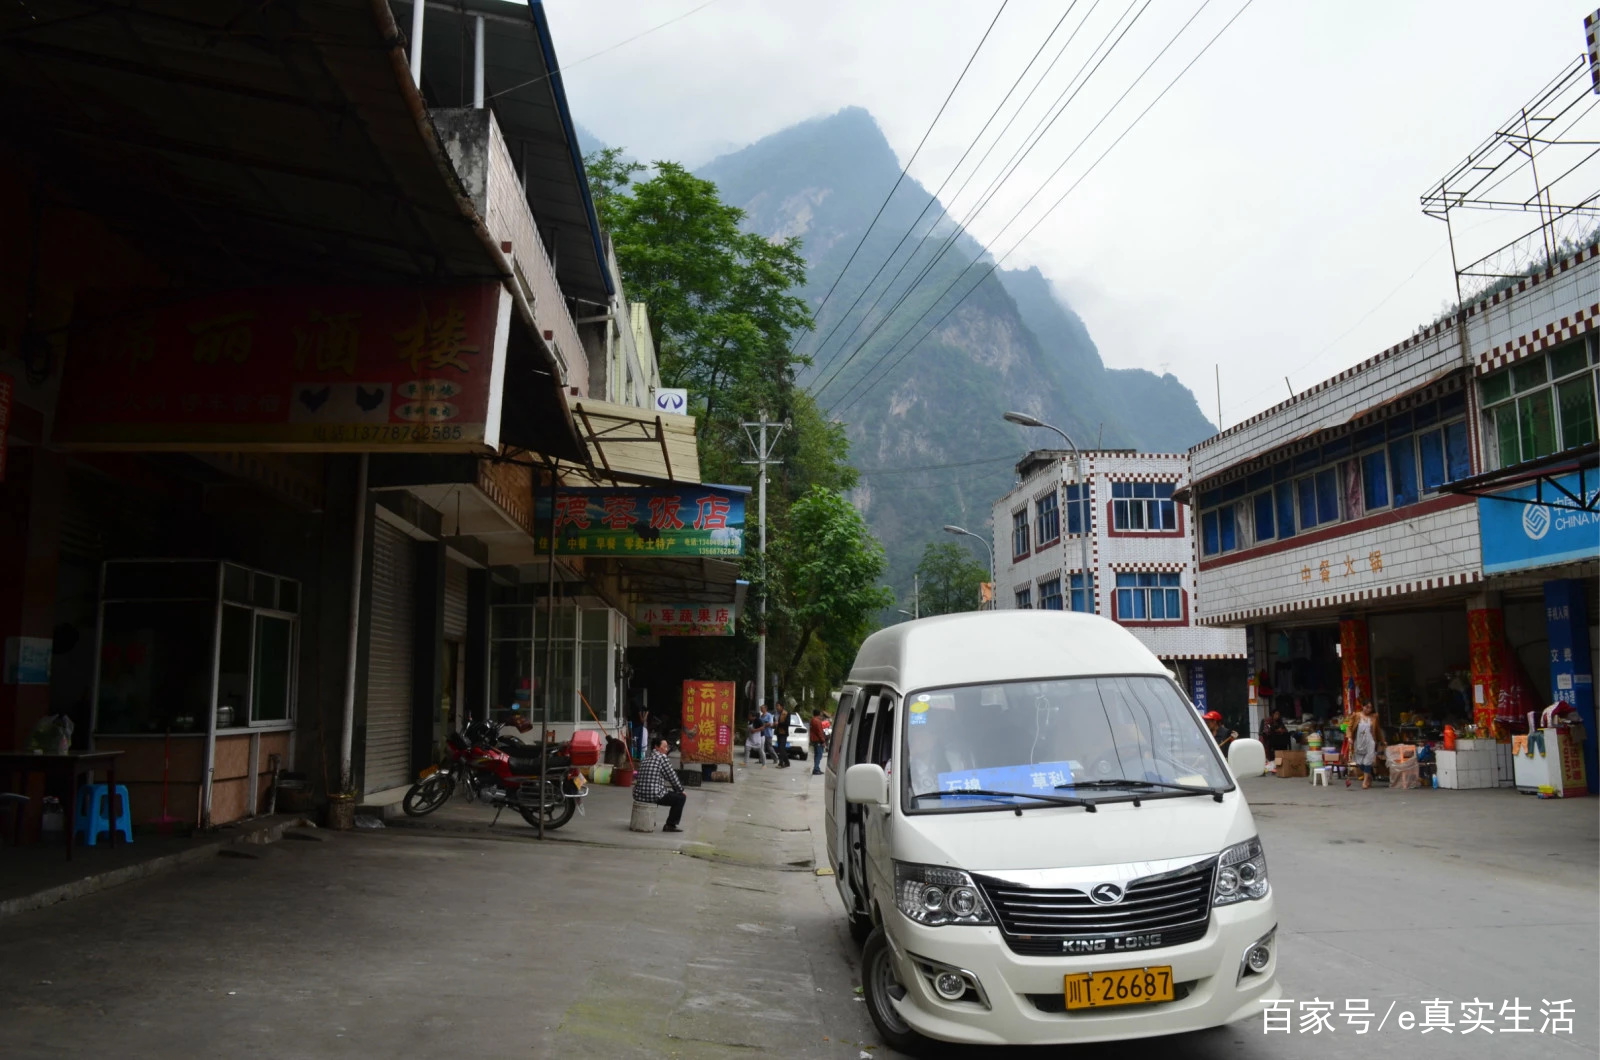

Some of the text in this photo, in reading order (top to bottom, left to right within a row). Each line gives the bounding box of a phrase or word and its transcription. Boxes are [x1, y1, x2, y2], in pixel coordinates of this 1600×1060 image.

[1555, 512, 1590, 531] CHINA
[644, 608, 729, 623] 小军蔬果店
[697, 682, 717, 755] 云川烧烤
[1030, 770, 1068, 790] 草科
[1062, 934, 1162, 952] KING LONG
